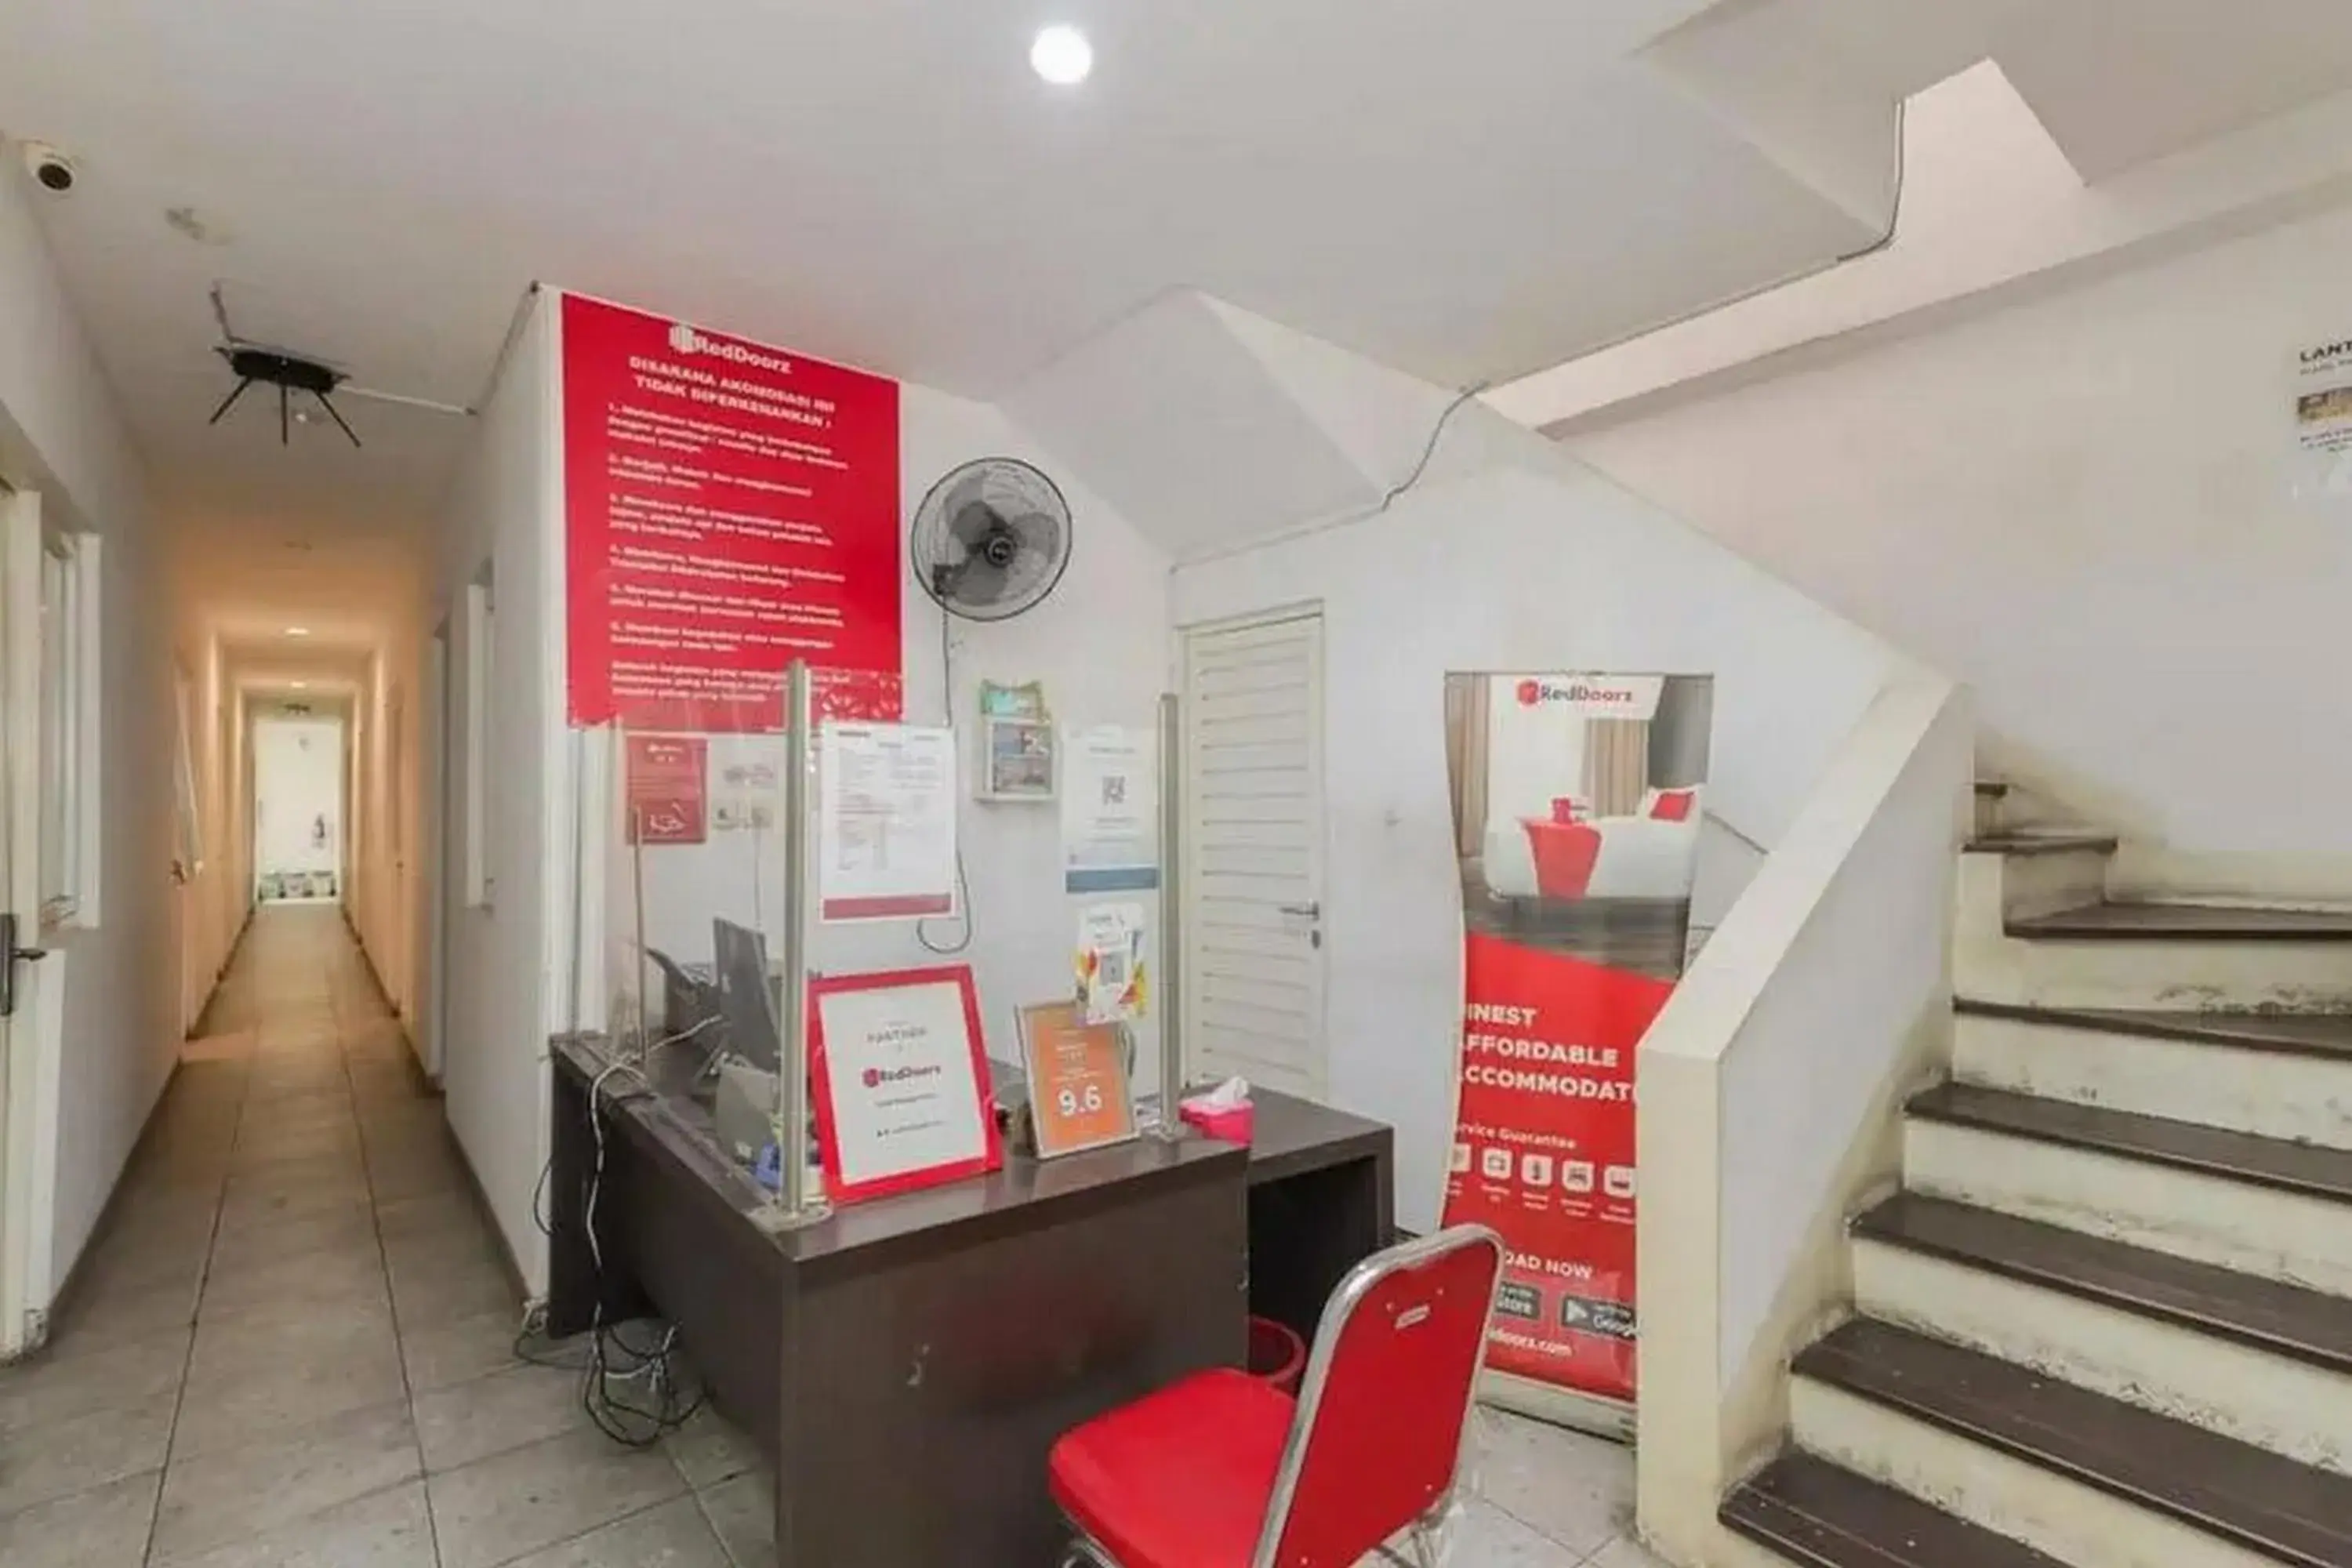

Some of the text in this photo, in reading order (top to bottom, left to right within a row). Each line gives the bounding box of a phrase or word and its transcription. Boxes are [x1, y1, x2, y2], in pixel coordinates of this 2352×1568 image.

[2299, 339, 2352, 363] LANT
[633, 374, 687, 398] TIDAK
[1541, 684, 1633, 702] RedDoorz
[1468, 1003, 1537, 1029] INEST
[1467, 1034, 1619, 1069] FFORDABLE
[1465, 1065, 1632, 1102] CCOMMODAT
[1058, 1084, 1103, 1117] 9.6
[1459, 1122, 1577, 1150] rvice Guarantee
[1505, 1250, 1593, 1280] OAD NOW
